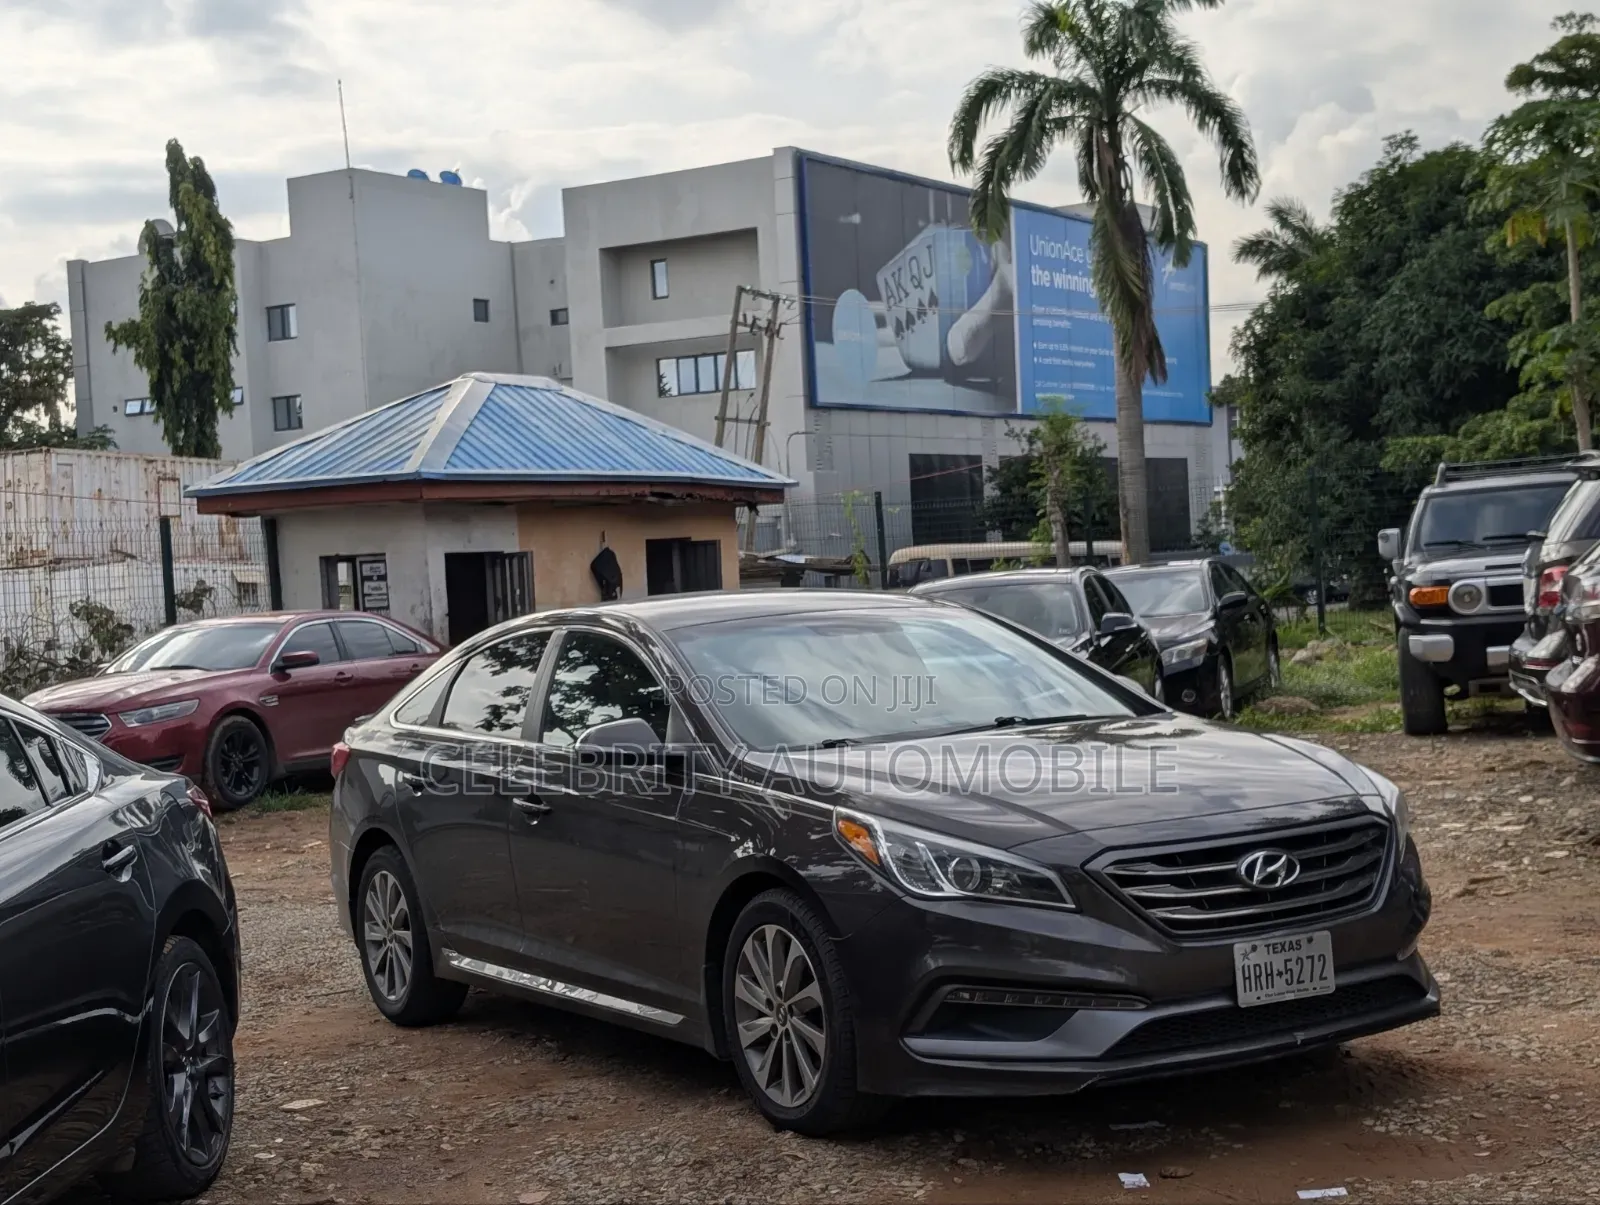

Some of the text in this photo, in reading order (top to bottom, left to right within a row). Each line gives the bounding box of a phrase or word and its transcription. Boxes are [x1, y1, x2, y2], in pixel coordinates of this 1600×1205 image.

[1029, 234, 1084, 263] UnionAce
[1031, 264, 1096, 299] the winning
[1264, 940, 1302, 955] TEXAS
